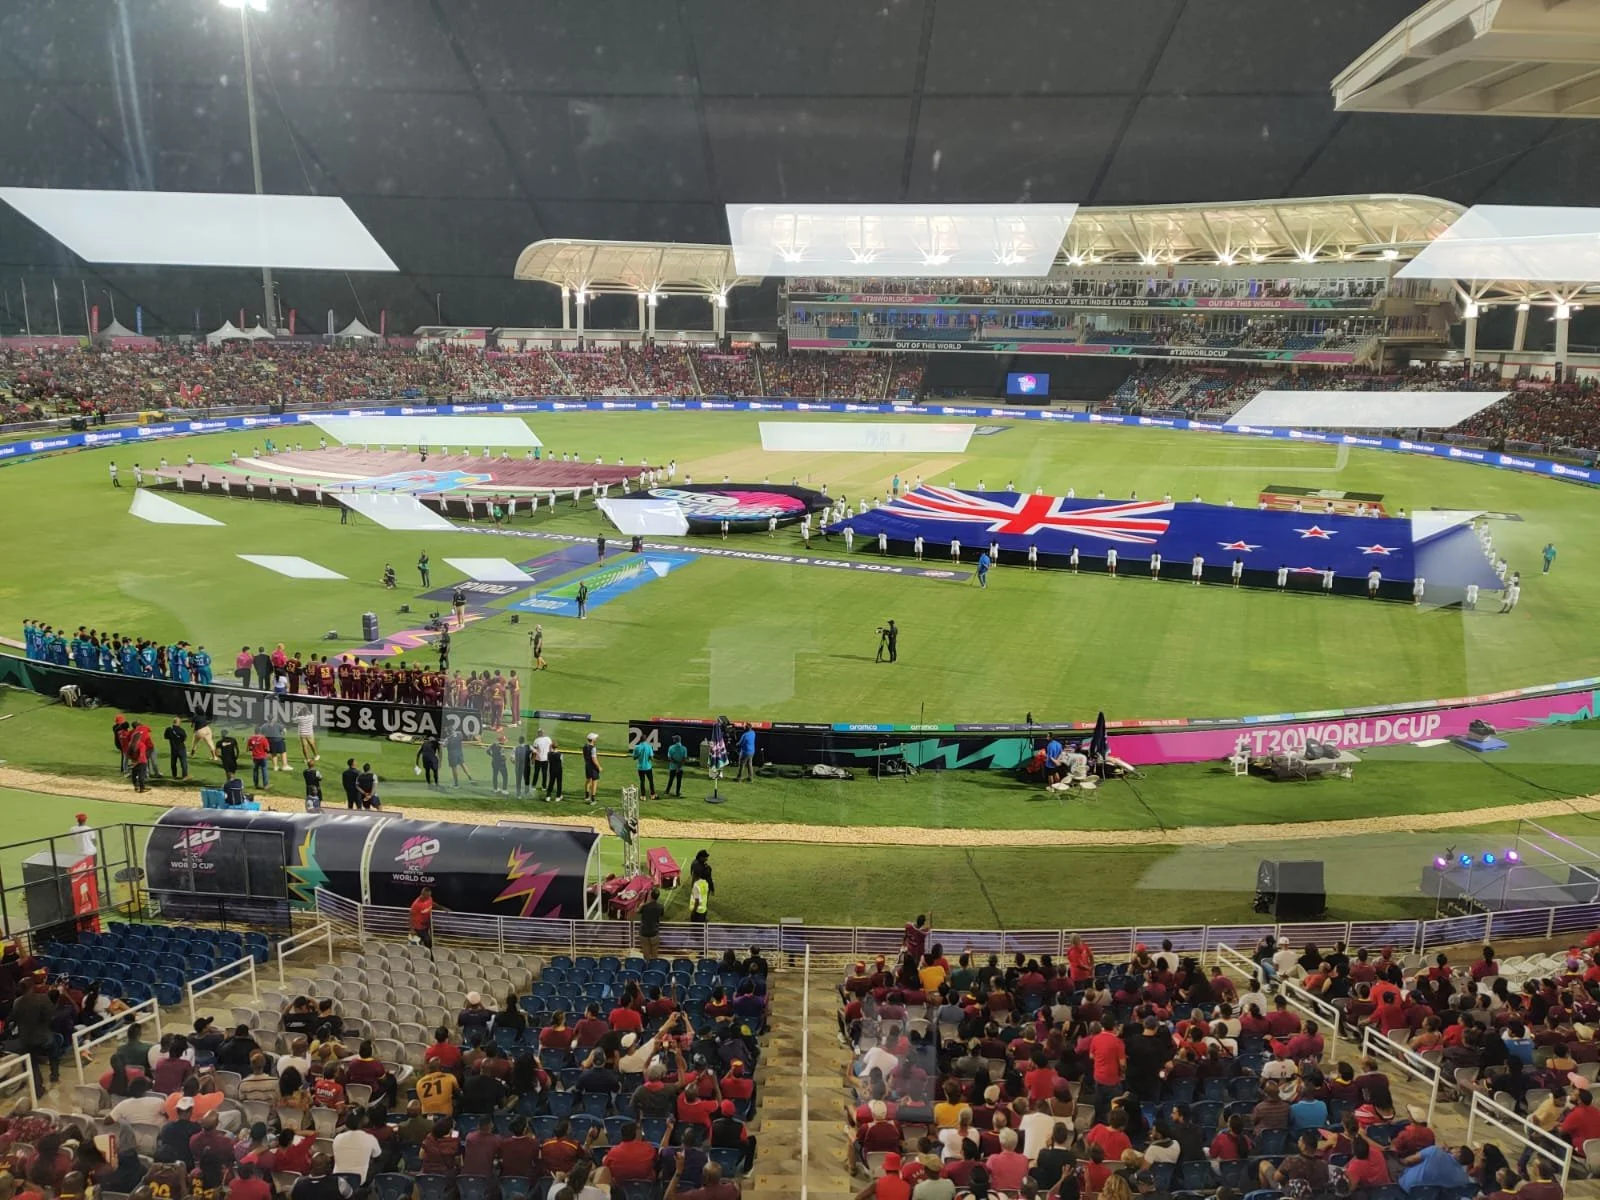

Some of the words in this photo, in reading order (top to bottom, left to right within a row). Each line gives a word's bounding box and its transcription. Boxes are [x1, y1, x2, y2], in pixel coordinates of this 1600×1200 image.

[1169, 349, 1229, 358] #T20WORLDCUP
[642, 542, 679, 550] CUP
[683, 546, 737, 556] WEST
[813, 559, 851, 568] USA
[854, 564, 903, 573] 2024
[185, 689, 257, 720] WEST
[358, 706, 377, 731] &
[382, 708, 438, 735] USA
[628, 726, 662, 752] 24
[1234, 714, 1441, 754] #T20WORLDCUP
[171, 861, 198, 869] WORD
[199, 862, 214, 870] CUP
[392, 873, 419, 882] WORLD
[420, 875, 436, 883] CUP
[421, 1079, 444, 1099] 21
